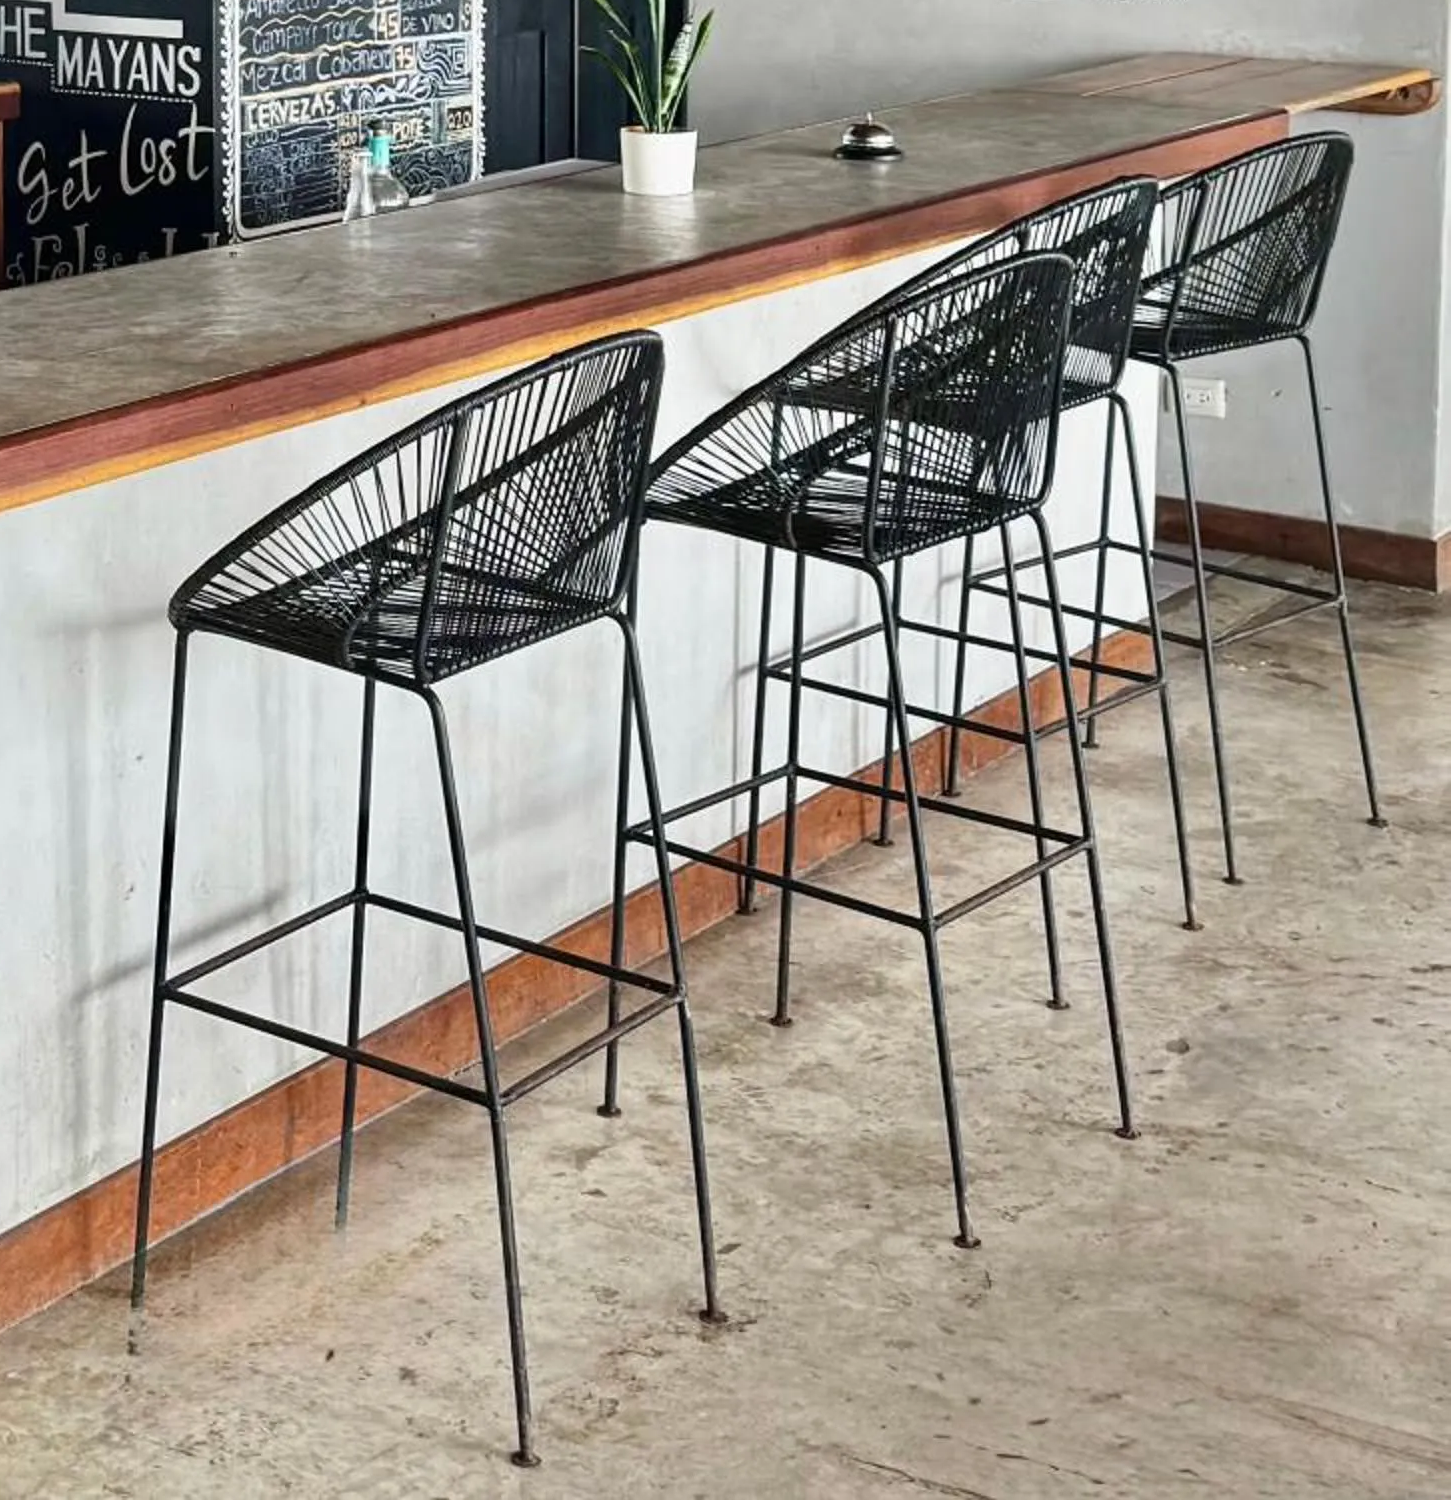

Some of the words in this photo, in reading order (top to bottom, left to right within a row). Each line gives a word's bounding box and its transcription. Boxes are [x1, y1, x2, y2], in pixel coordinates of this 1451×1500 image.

[378, 11, 398, 38] 45
[57, 34, 203, 98] MAYANS
[17, 130, 109, 226] Get
[119, 102, 217, 197] Lost
